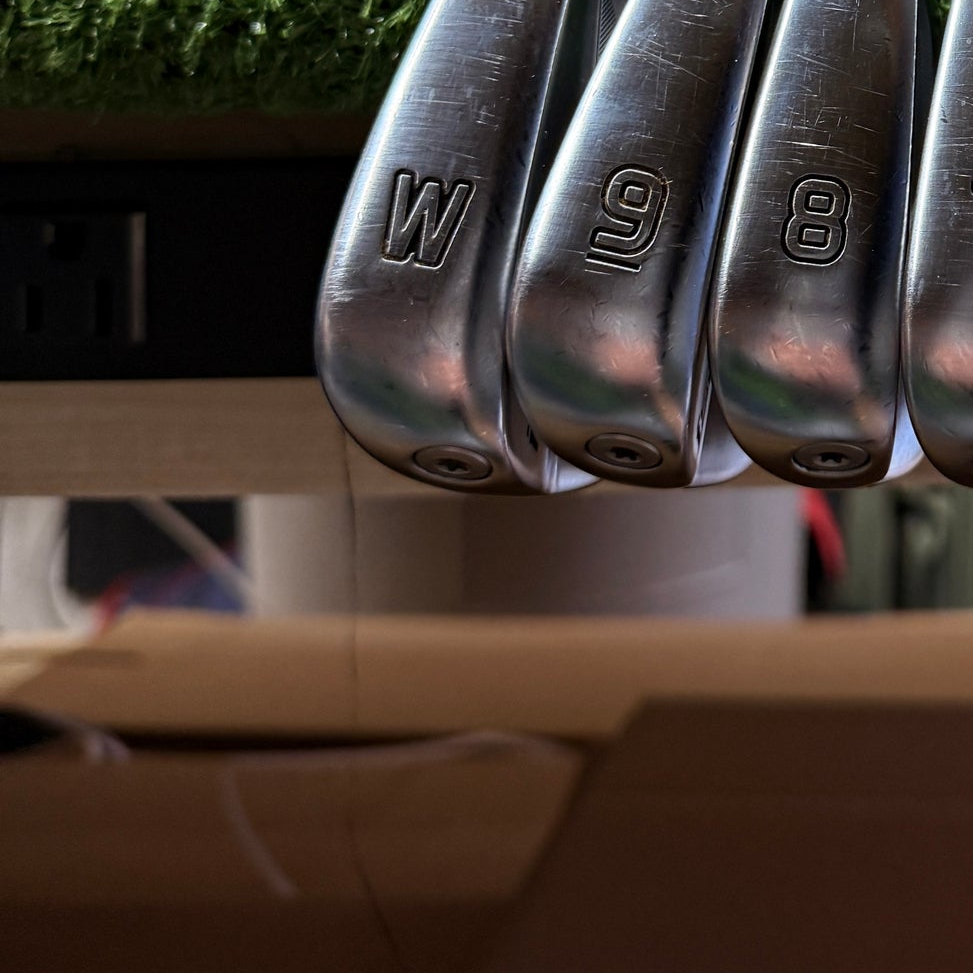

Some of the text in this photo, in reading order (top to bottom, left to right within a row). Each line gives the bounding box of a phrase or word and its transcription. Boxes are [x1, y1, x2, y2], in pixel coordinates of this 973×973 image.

[382, 168, 477, 269] W
[588, 164, 670, 259] 9
[780, 173, 852, 266] 8
